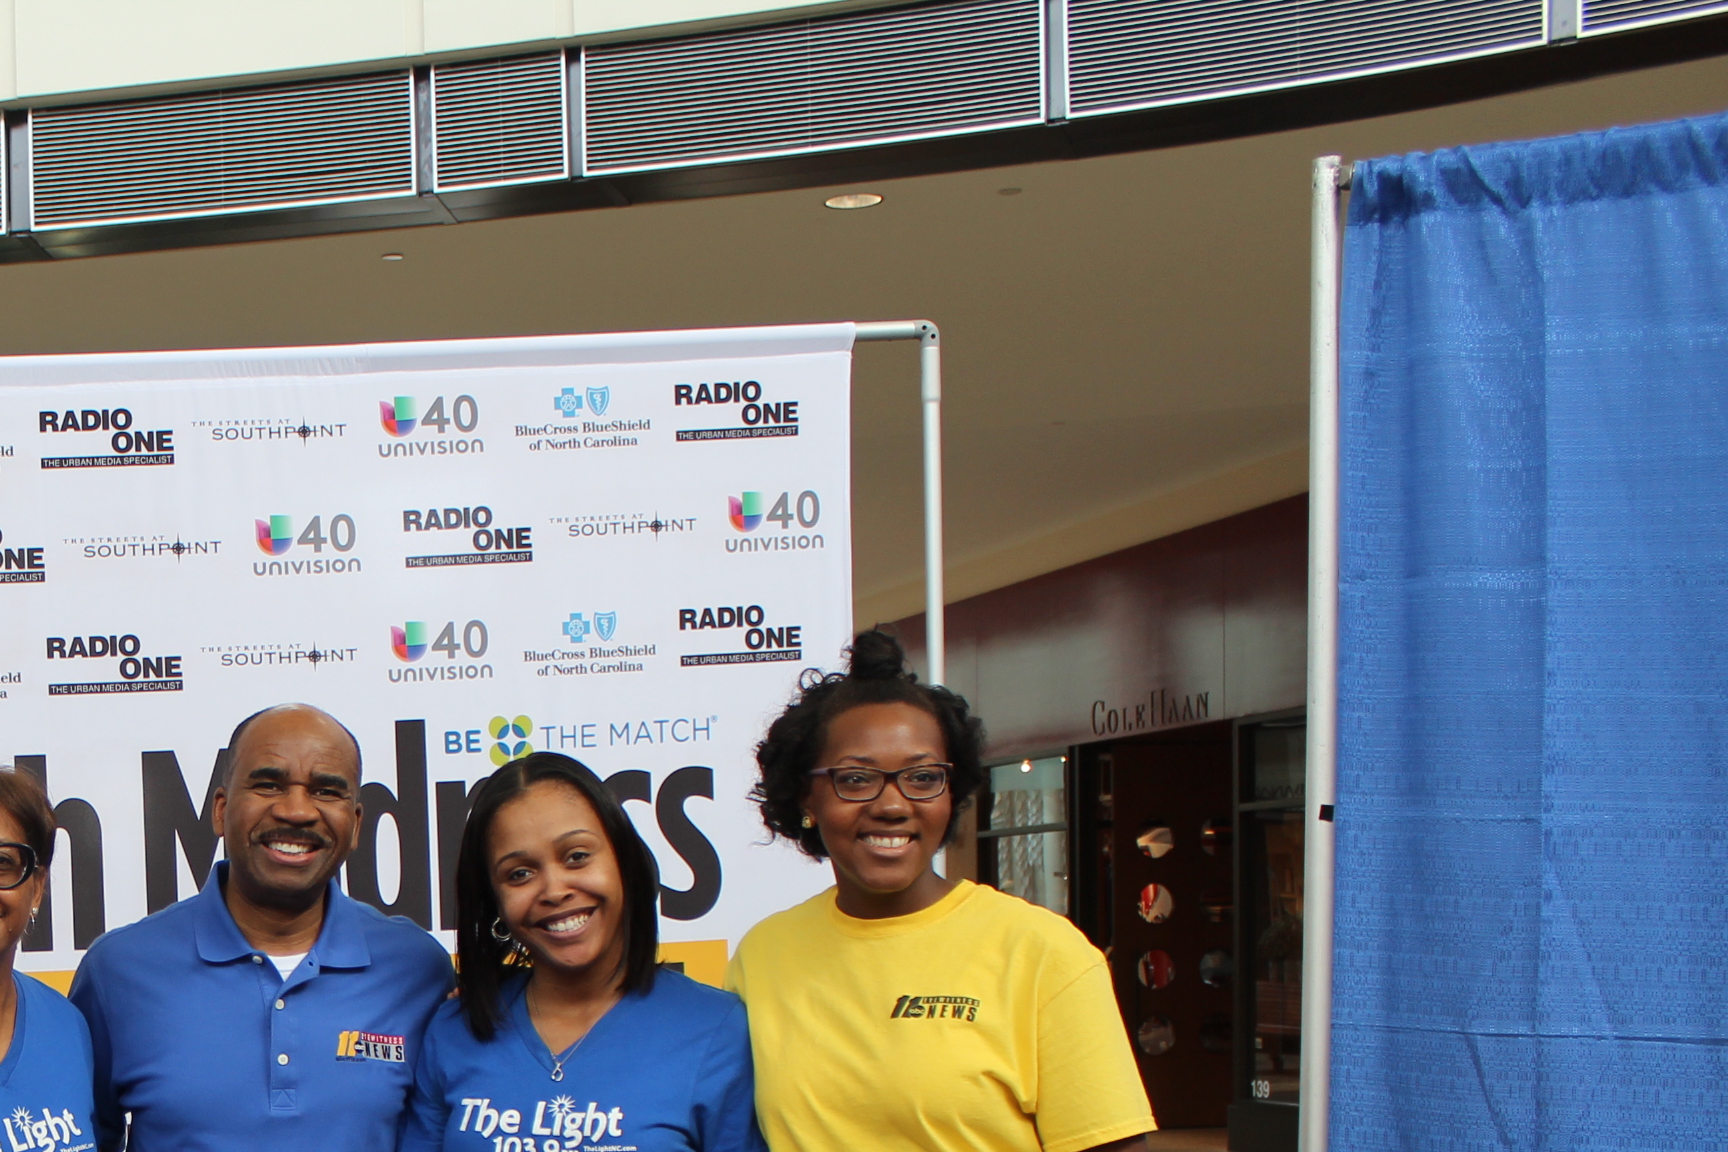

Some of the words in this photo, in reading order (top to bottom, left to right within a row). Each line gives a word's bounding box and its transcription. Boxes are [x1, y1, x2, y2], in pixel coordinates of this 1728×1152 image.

[674, 380, 762, 409] RADIO
[39, 407, 133, 434] RADIO
[421, 393, 478, 435] 40
[741, 400, 799, 426] ONE
[515, 422, 579, 437] BlueCross
[582, 418, 651, 433] BlueShield
[678, 431, 693, 440] THE
[696, 430, 722, 440] URBAN
[725, 428, 749, 438] MEDIA
[752, 426, 797, 437] SPECIALIST
[111, 429, 174, 454] ONE
[378, 438, 484, 458] UNIVISION
[529, 439, 543, 451] of
[545, 437, 581, 450] North
[583, 434, 638, 448] Carolina
[403, 505, 493, 535] RADIO
[762, 489, 820, 531] 40
[296, 513, 356, 554] 40
[472, 524, 532, 552] ONE
[725, 533, 824, 554] UNIVISION
[253, 557, 362, 577] UNIVISION
[679, 604, 764, 634] RADIO
[46, 633, 141, 661] RADIO
[431, 619, 488, 661] 40
[744, 625, 802, 651] ONE
[524, 647, 586, 662] BlueCross
[589, 644, 656, 659] BlueShield
[119, 655, 183, 680] ONE
[388, 664, 493, 683] UNIVISION
[537, 665, 550, 677] of
[553, 663, 588, 676] North
[590, 660, 643, 674] Carolina
[444, 729, 483, 754] BE
[539, 724, 598, 750] THE
[926, 1004, 977, 1022] NEWS
[365, 1042, 403, 1061] NEWS
[1251, 1080, 1270, 1098] 139
[459, 1098, 521, 1139] The
[532, 1100, 624, 1149] Light
